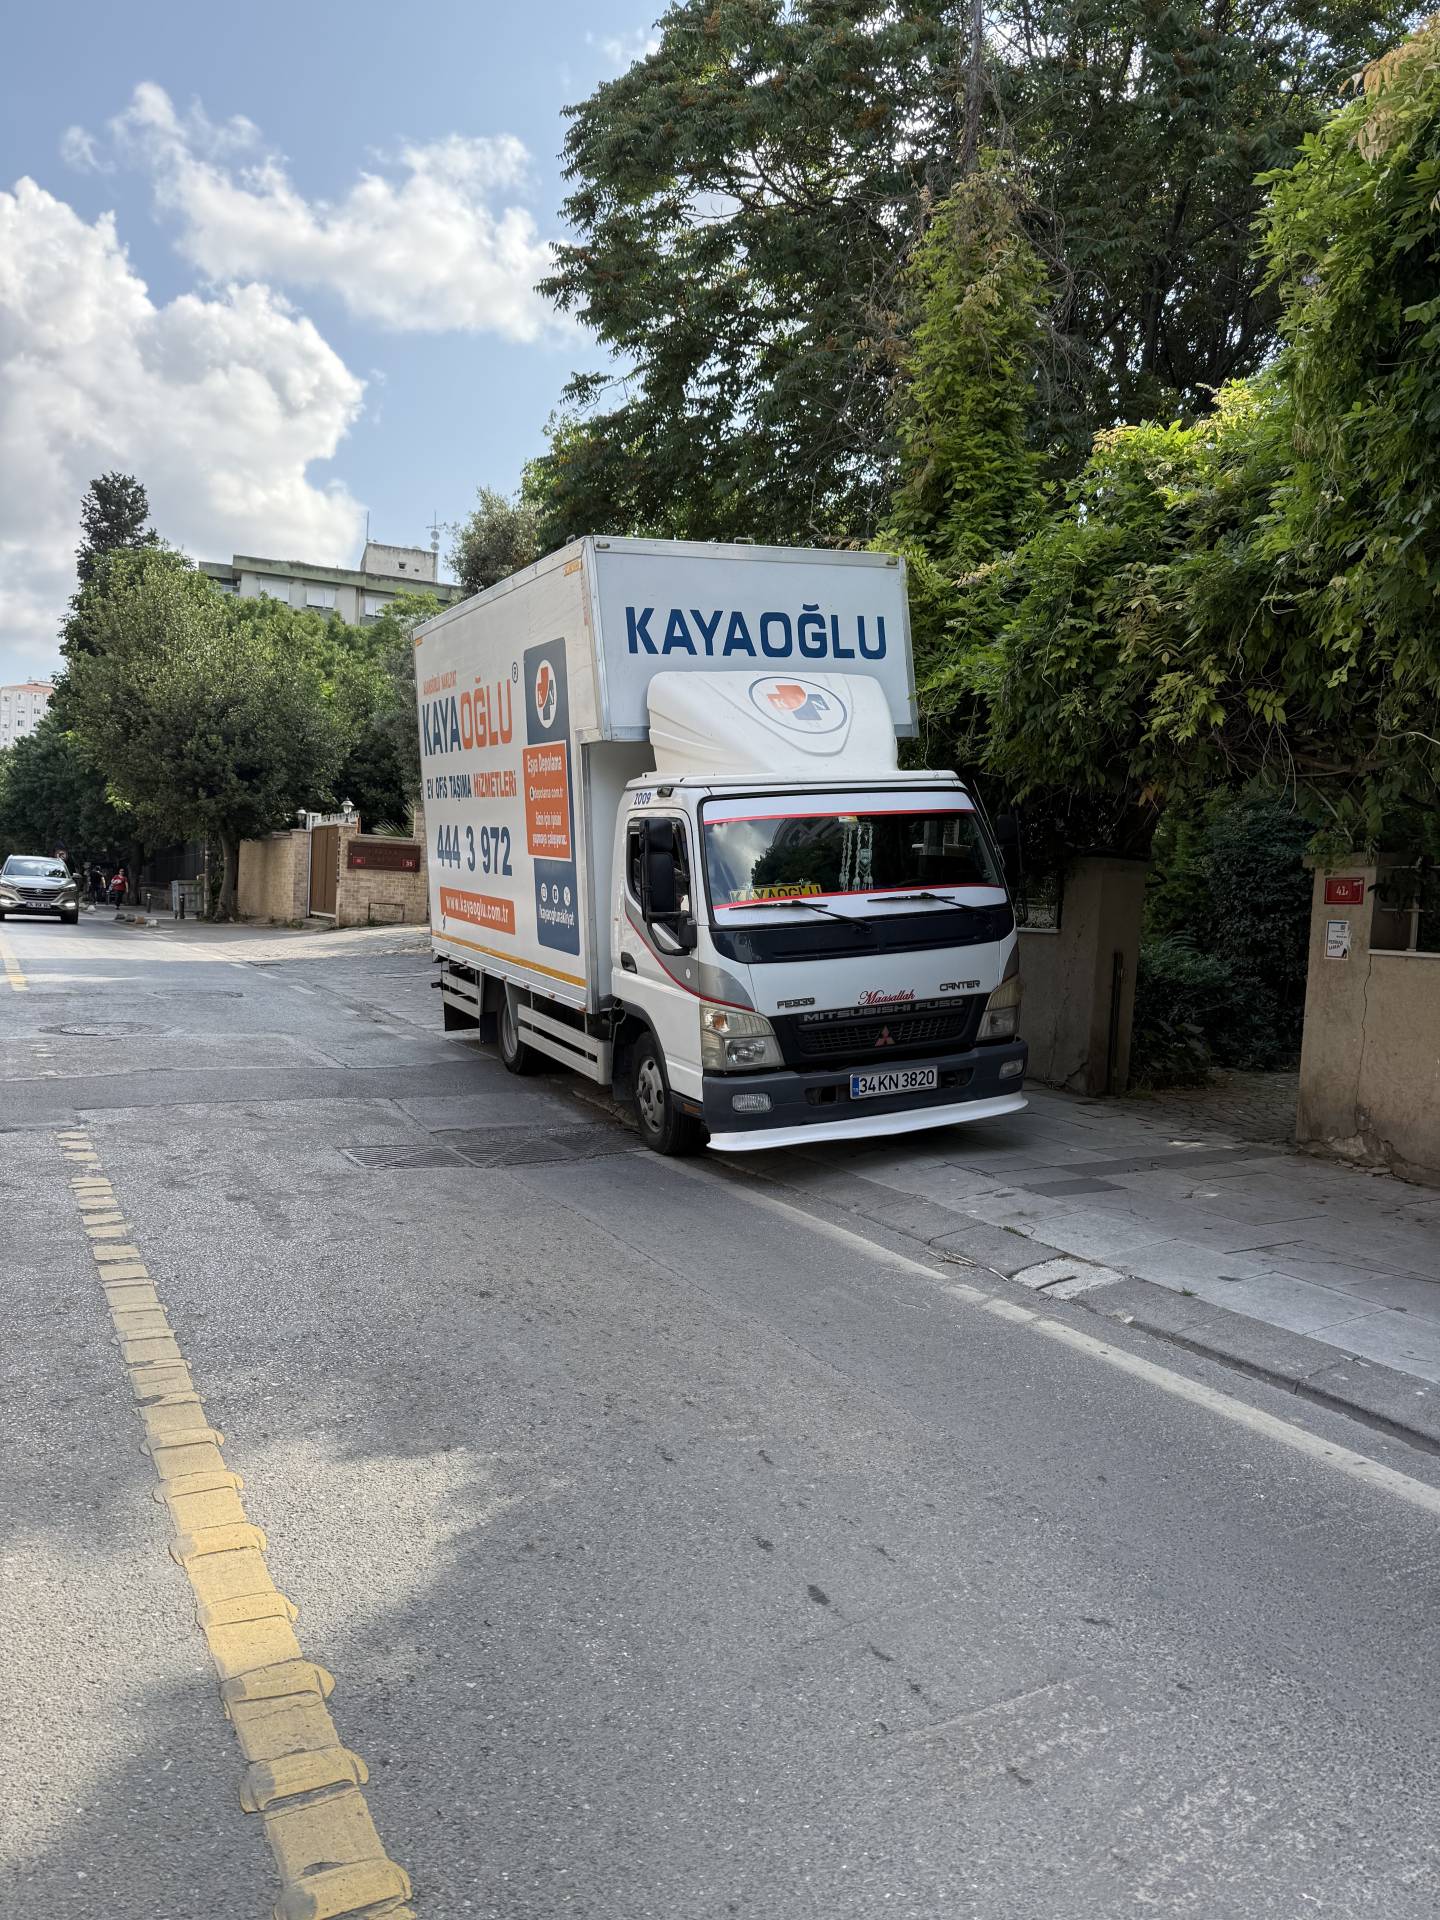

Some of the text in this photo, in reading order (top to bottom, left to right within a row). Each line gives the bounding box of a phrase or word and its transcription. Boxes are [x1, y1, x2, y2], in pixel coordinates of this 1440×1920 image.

[625, 603, 887, 660] KAYAOĞLU
[427, 778, 433, 799] EV
[437, 824, 513, 876] 444 3 972
[445, 893, 509, 923] www.kayaoglu.com.tr
[939, 979, 981, 992] CANTER
[803, 998, 963, 1022] MITSUBISHI FUSO
[901, 1069, 935, 1088] 3820
